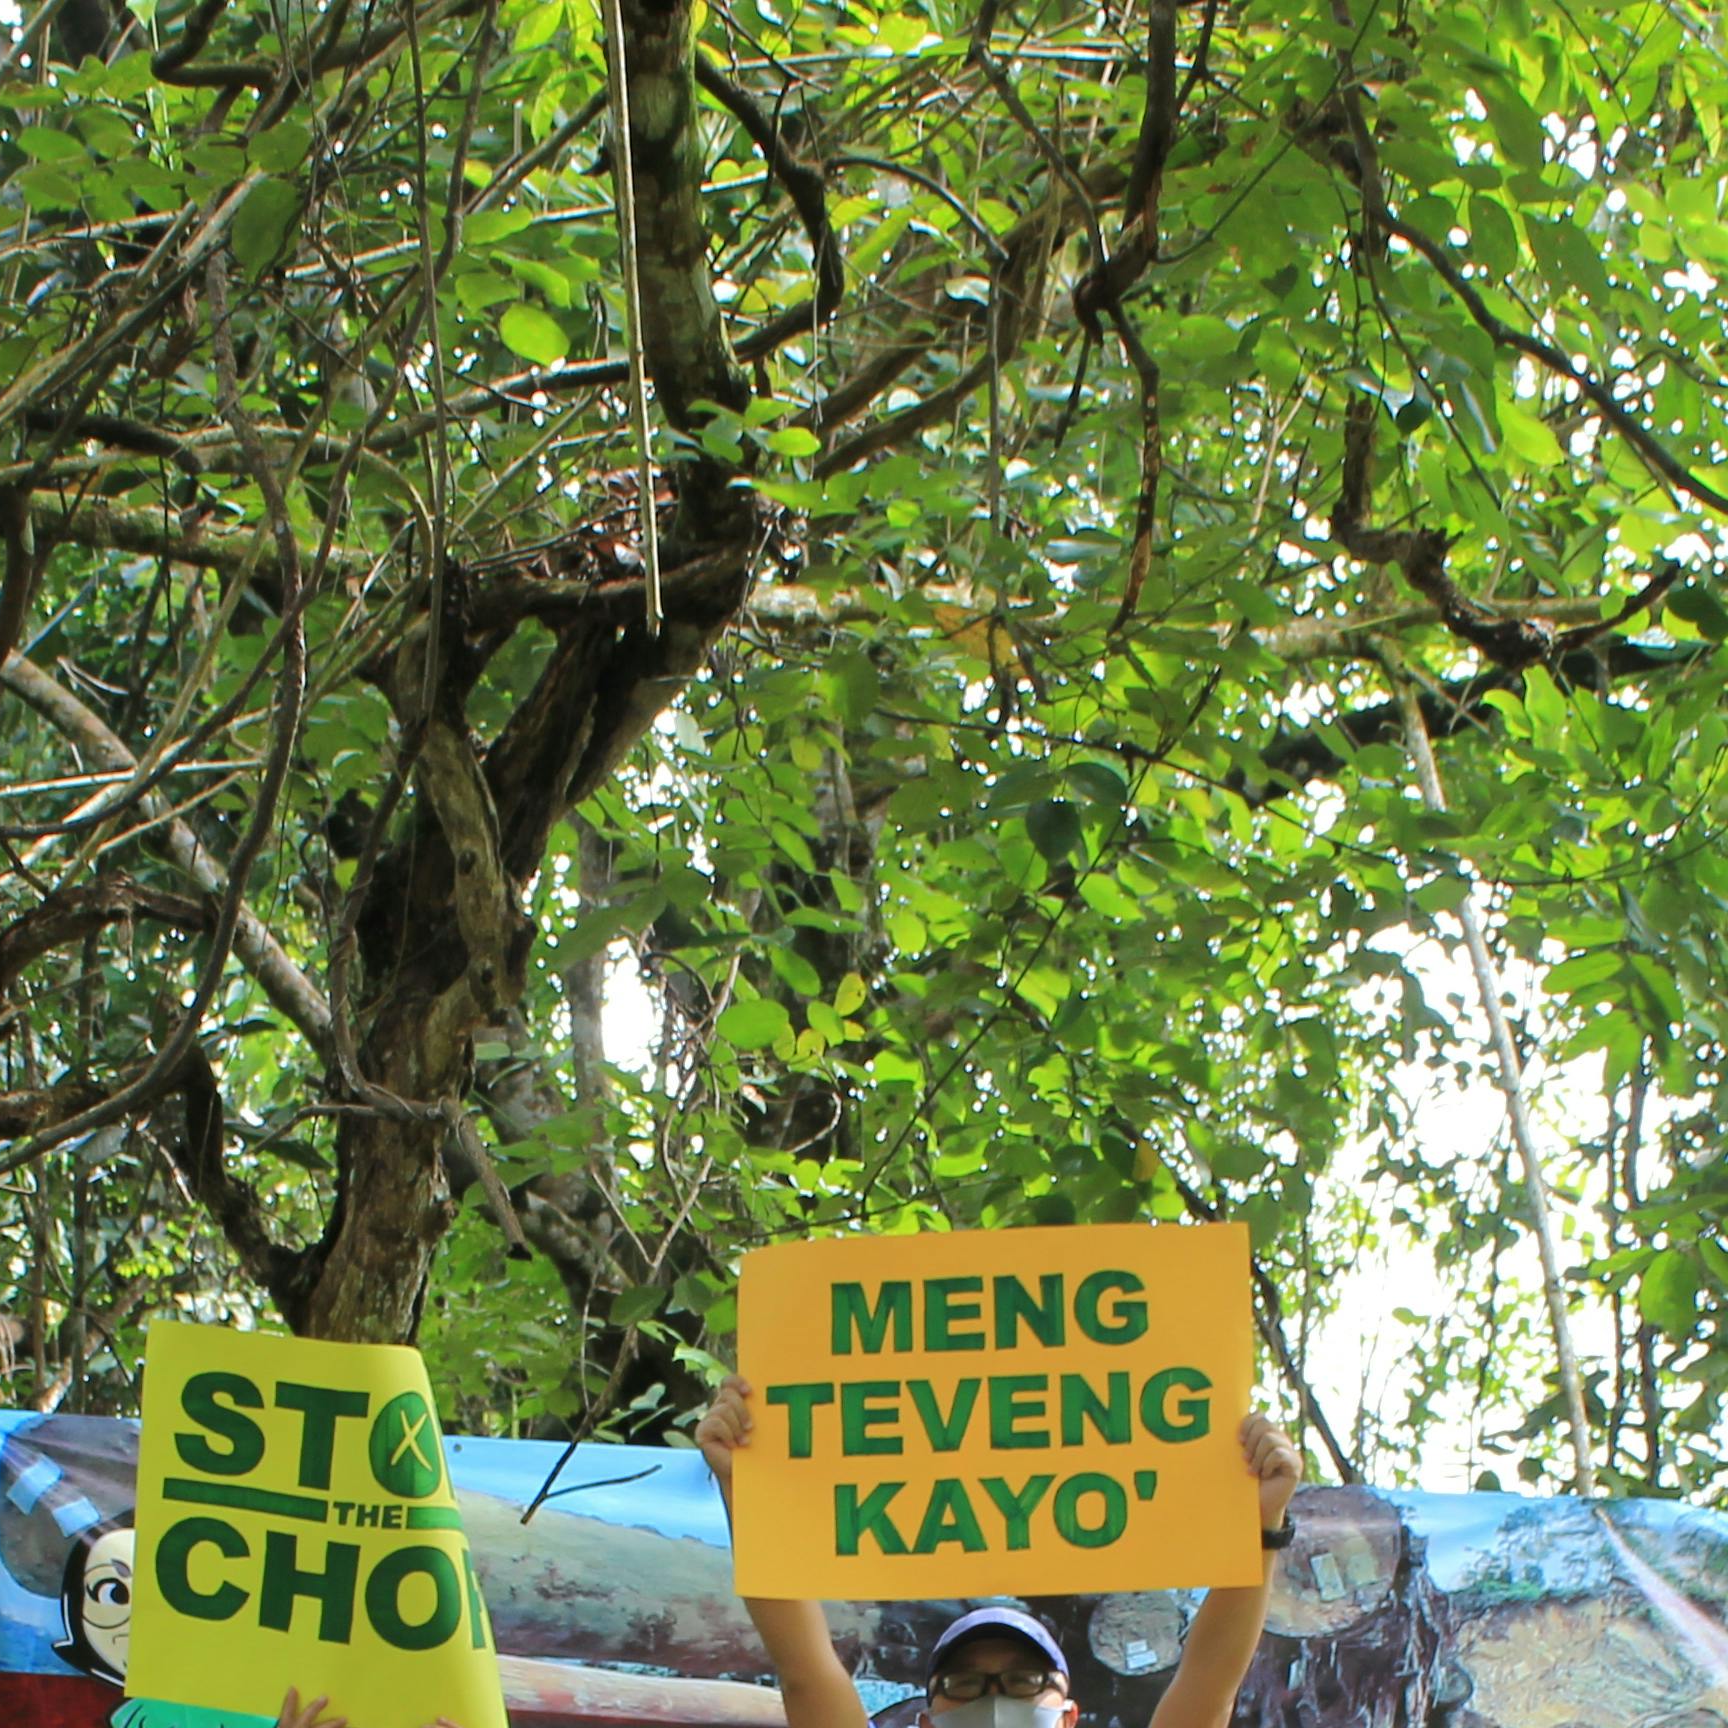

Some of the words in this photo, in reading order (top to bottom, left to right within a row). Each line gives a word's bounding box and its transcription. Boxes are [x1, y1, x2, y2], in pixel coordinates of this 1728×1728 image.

[831, 1270, 1148, 1356] MENG
[766, 1367, 1212, 1459] TEVENG
[333, 1501, 402, 1529] THE
[834, 1473, 1157, 1556] KAYO'
